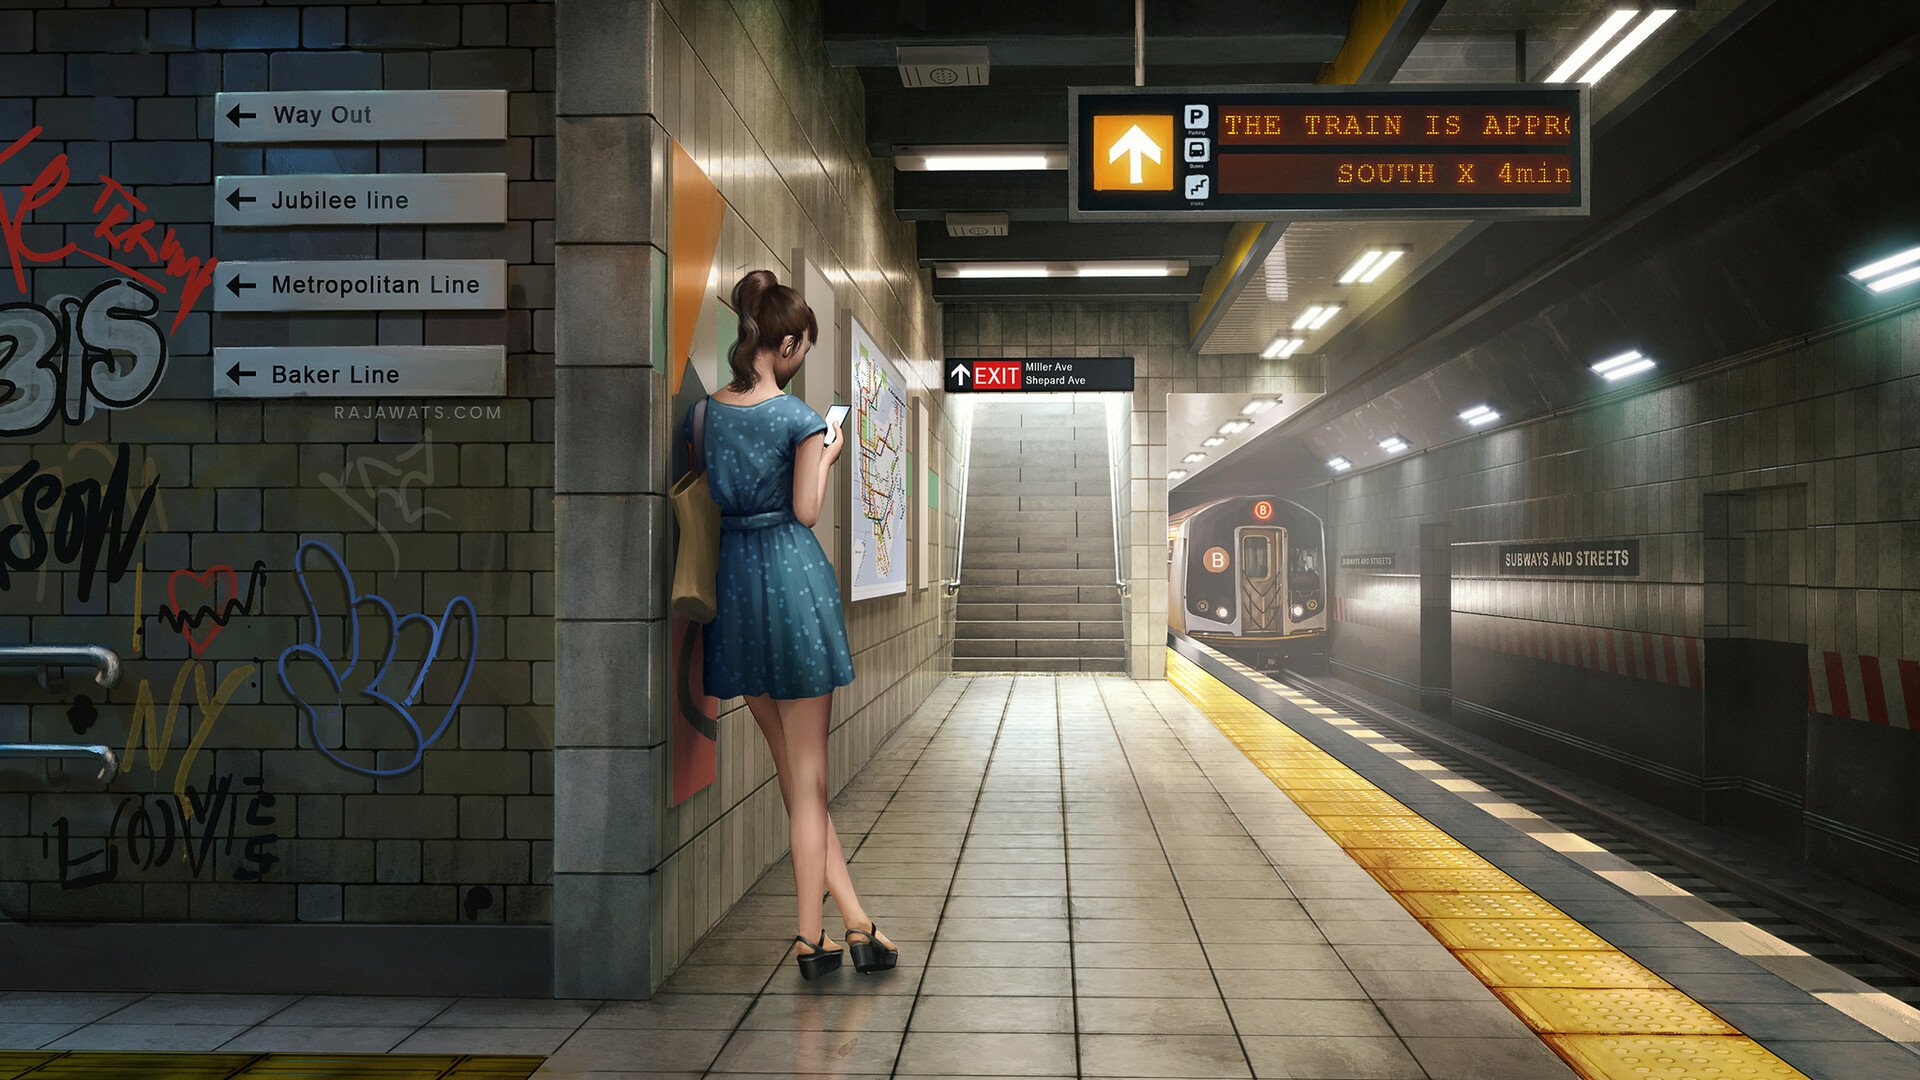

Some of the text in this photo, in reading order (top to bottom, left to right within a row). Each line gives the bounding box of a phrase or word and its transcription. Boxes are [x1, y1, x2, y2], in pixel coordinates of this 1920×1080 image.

[273, 105, 372, 128] Way Out
[1190, 109, 1204, 124] P
[1225, 115, 1281, 135] THE
[1305, 115, 1402, 135] TRAIN
[1426, 115, 1461, 135] IS
[1338, 160, 1572, 183] SOUTH X 4min
[271, 190, 409, 210] Jubilee line
[272, 275, 480, 299] Metropolitan Line
[272, 364, 400, 384] Baker Line
[974, 367, 1020, 385] EXIT
[1054, 362, 1073, 372] Ave
[1025, 375, 1086, 387] Shepard Ave
[1211, 552, 1224, 568] B
[1505, 549, 1629, 567] SUBWAYS AND STREETS
[121, 658, 256, 820] NY
